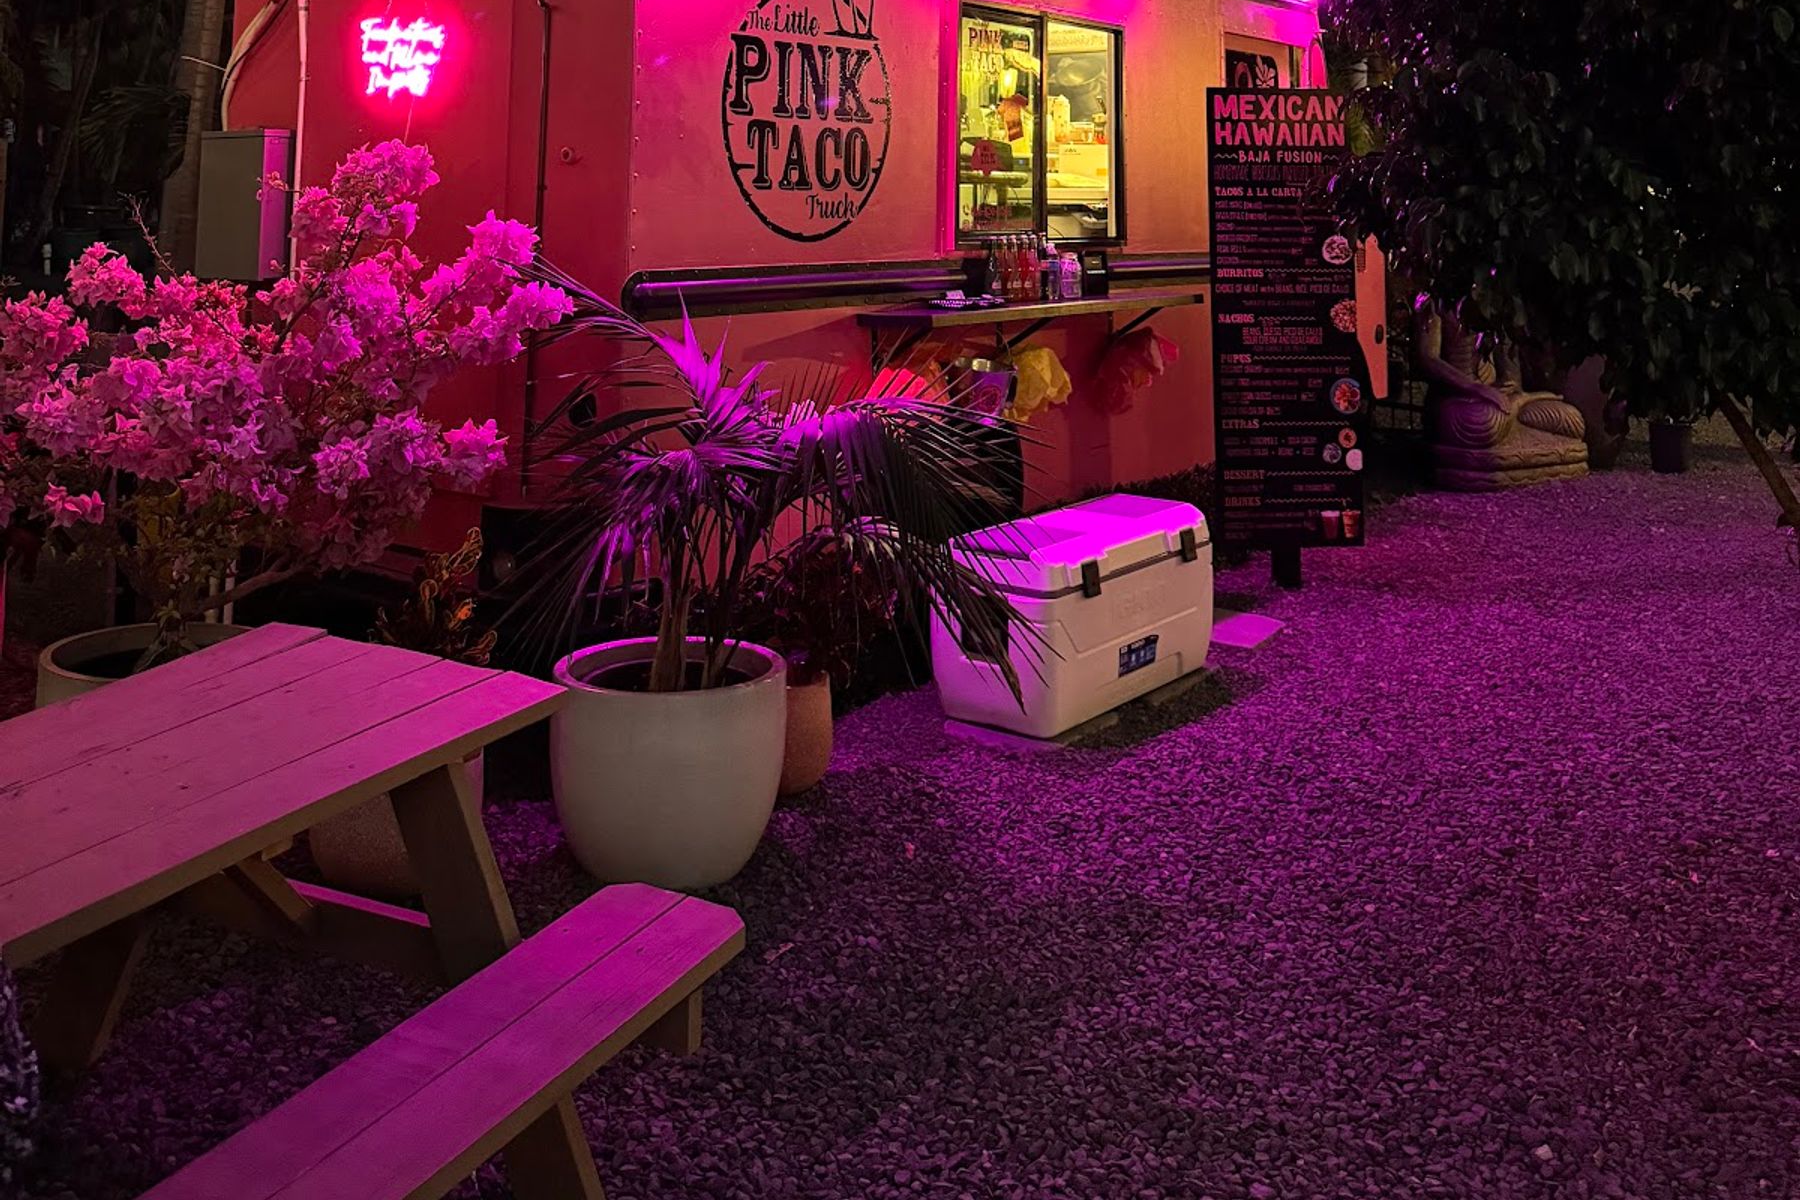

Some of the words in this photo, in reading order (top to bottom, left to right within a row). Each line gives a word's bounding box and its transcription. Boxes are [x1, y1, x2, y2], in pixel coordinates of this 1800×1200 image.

[747, 7, 772, 32] The
[773, 5, 820, 37] Little
[968, 27, 1003, 49] PINK
[972, 49, 1005, 74] TACO
[730, 33, 873, 123] PINK
[1213, 94, 1345, 121] MEXICAN
[1214, 121, 1345, 147] HAWAIIAN
[747, 119, 873, 191] TACO
[1238, 150, 1271, 164] BAJA
[1276, 150, 1323, 164] FUSION
[1214, 186, 1245, 198] TACOS
[1246, 186, 1254, 197] A
[1256, 187, 1269, 197] LA
[806, 192, 858, 220] Truck
[1216, 268, 1264, 278] BURRITOS
[1218, 313, 1255, 323] NACHOS
[1221, 419, 1260, 429] EXTRAS
[1223, 470, 1265, 480] DESSERT
[1225, 497, 1261, 506] DRINKS
